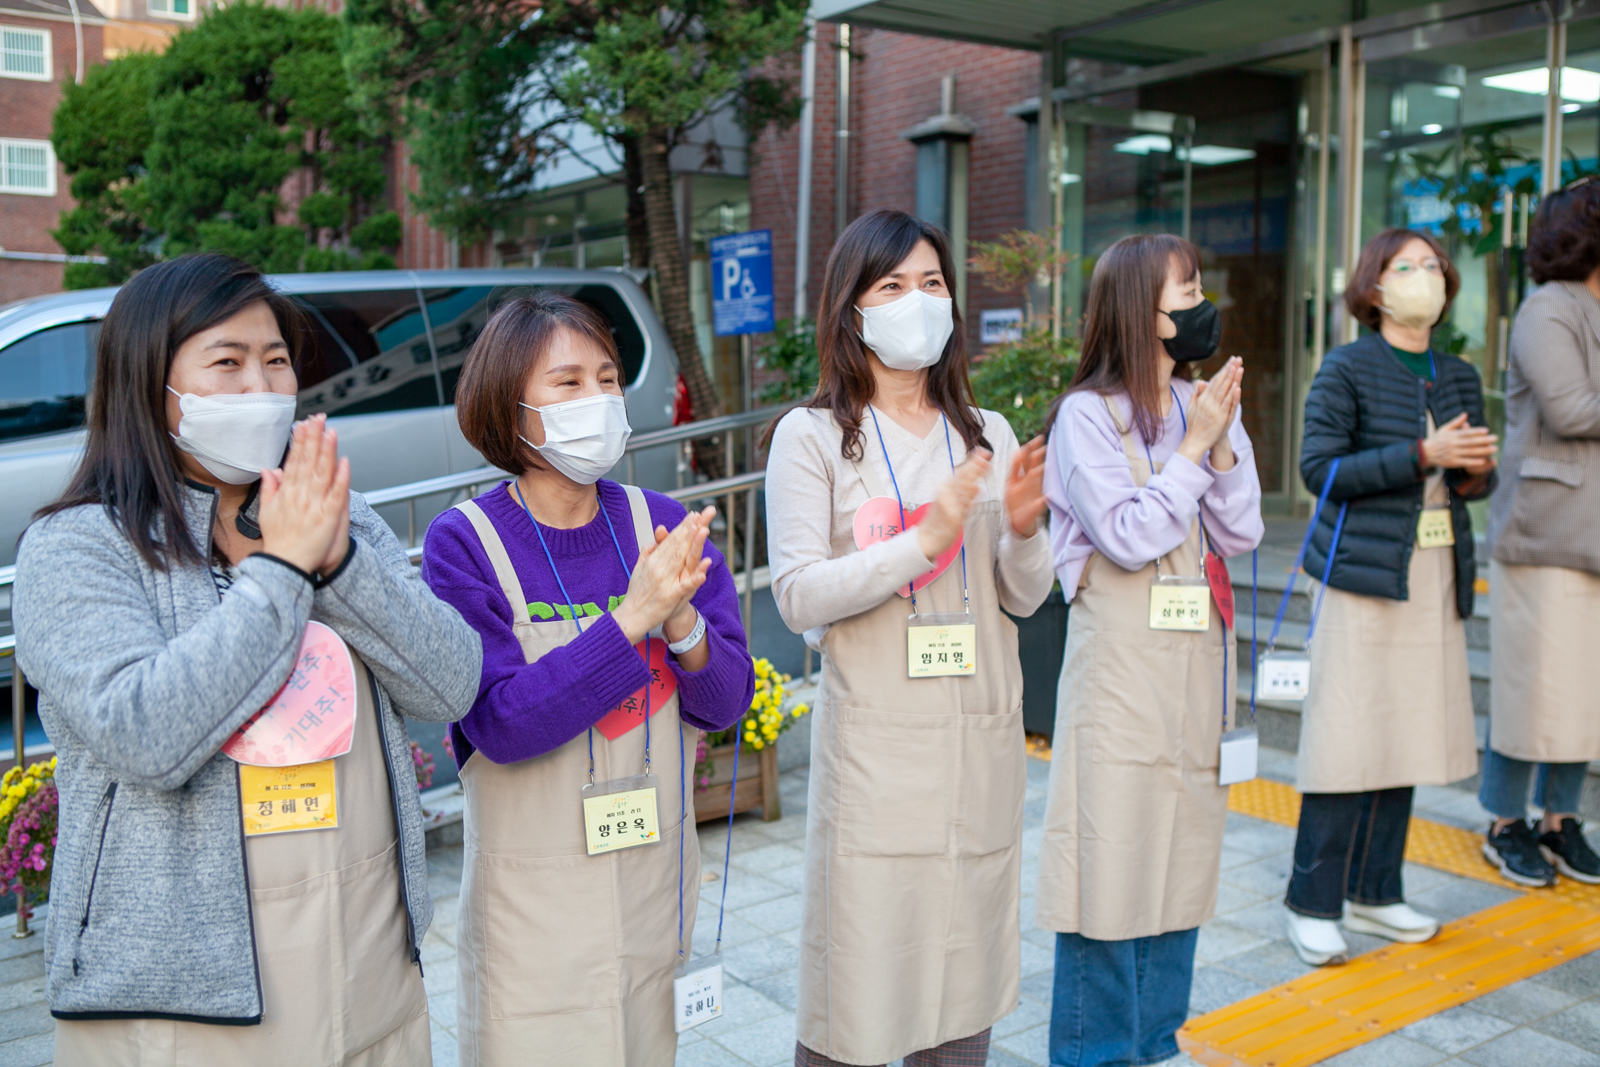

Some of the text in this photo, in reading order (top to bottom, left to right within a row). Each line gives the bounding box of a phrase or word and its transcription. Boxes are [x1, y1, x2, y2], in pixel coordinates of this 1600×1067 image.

[722, 258, 741, 301] P
[613, 697, 646, 716] 주!
[282, 687, 347, 748] 기대주!
[257, 796, 319, 817] 정혜연
[598, 817, 645, 838] 양은옥
